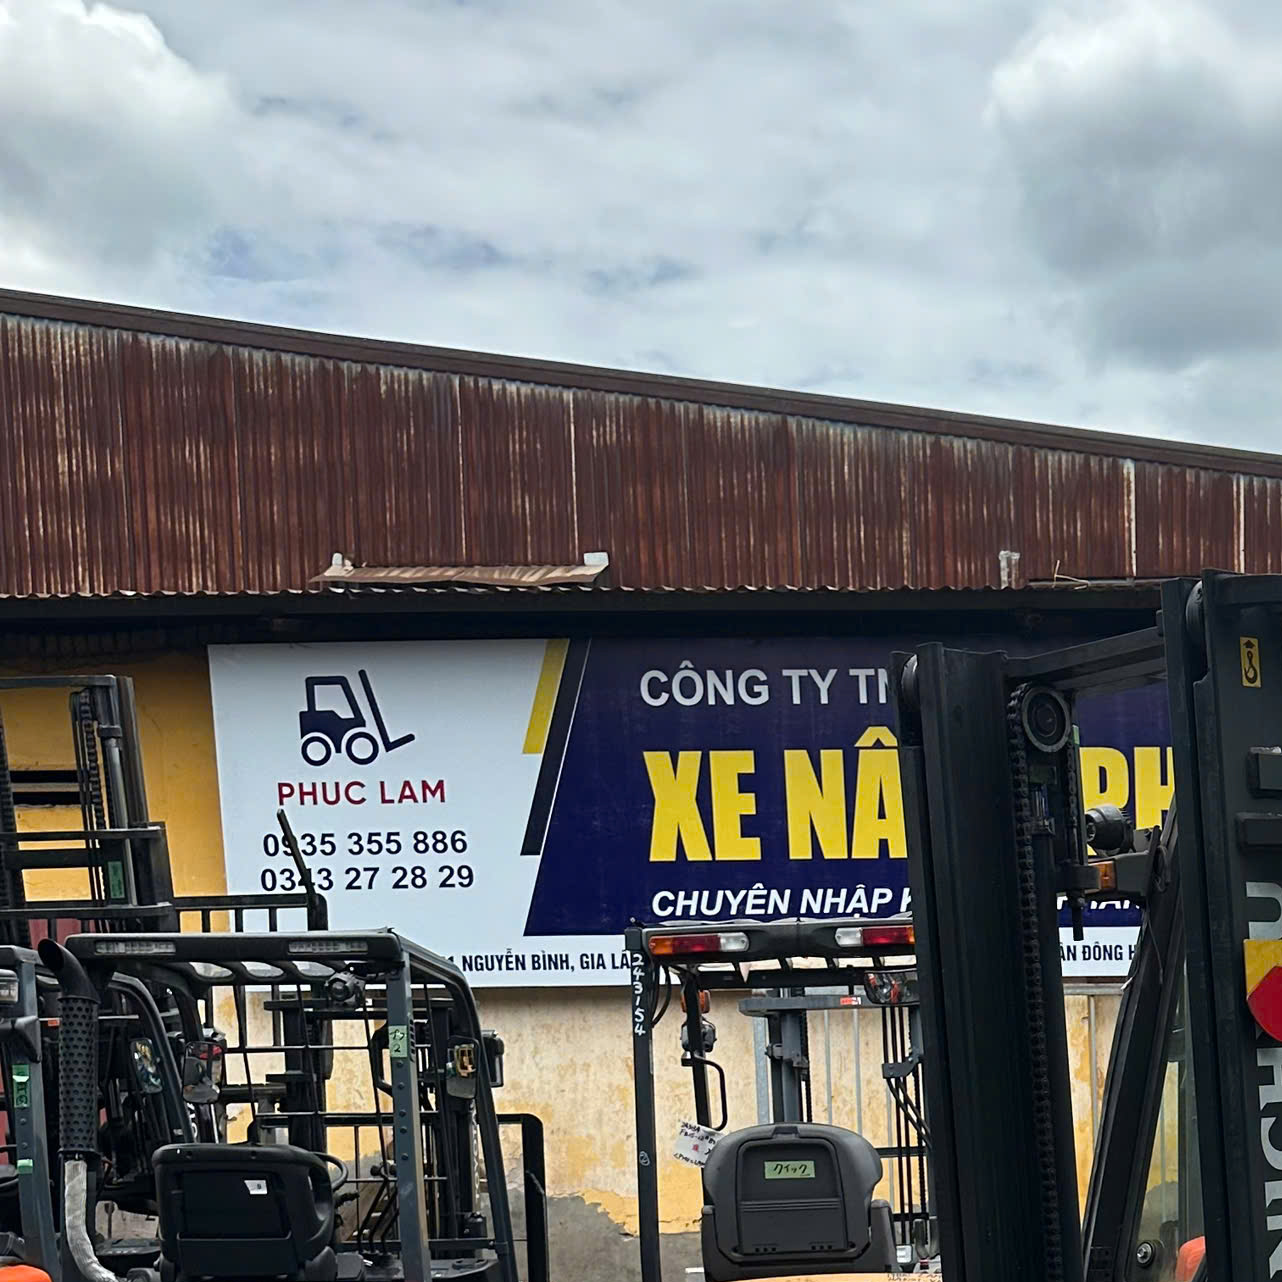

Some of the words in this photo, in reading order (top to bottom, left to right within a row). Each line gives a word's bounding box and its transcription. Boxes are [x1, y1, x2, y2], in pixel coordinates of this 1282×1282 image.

[640, 660, 769, 706] CÔNG
[782, 668, 838, 704] TY
[277, 781, 367, 805] PHUC
[379, 780, 446, 804] LAM
[643, 750, 762, 862] XE
[784, 726, 908, 860] NÂ
[347, 831, 402, 855] 355
[413, 830, 468, 854] 886
[345, 867, 380, 890] 27
[392, 866, 427, 889] 28
[438, 864, 474, 888] 29
[652, 883, 791, 917] CHUYÊN
[800, 884, 893, 919] NHẬP
[462, 948, 526, 972] NGUYỄN
[531, 950, 575, 972] BÌNH,
[580, 953, 606, 970] GIA
[1082, 941, 1123, 961] ĐÔNG
[632, 953, 646, 1036] 243154
